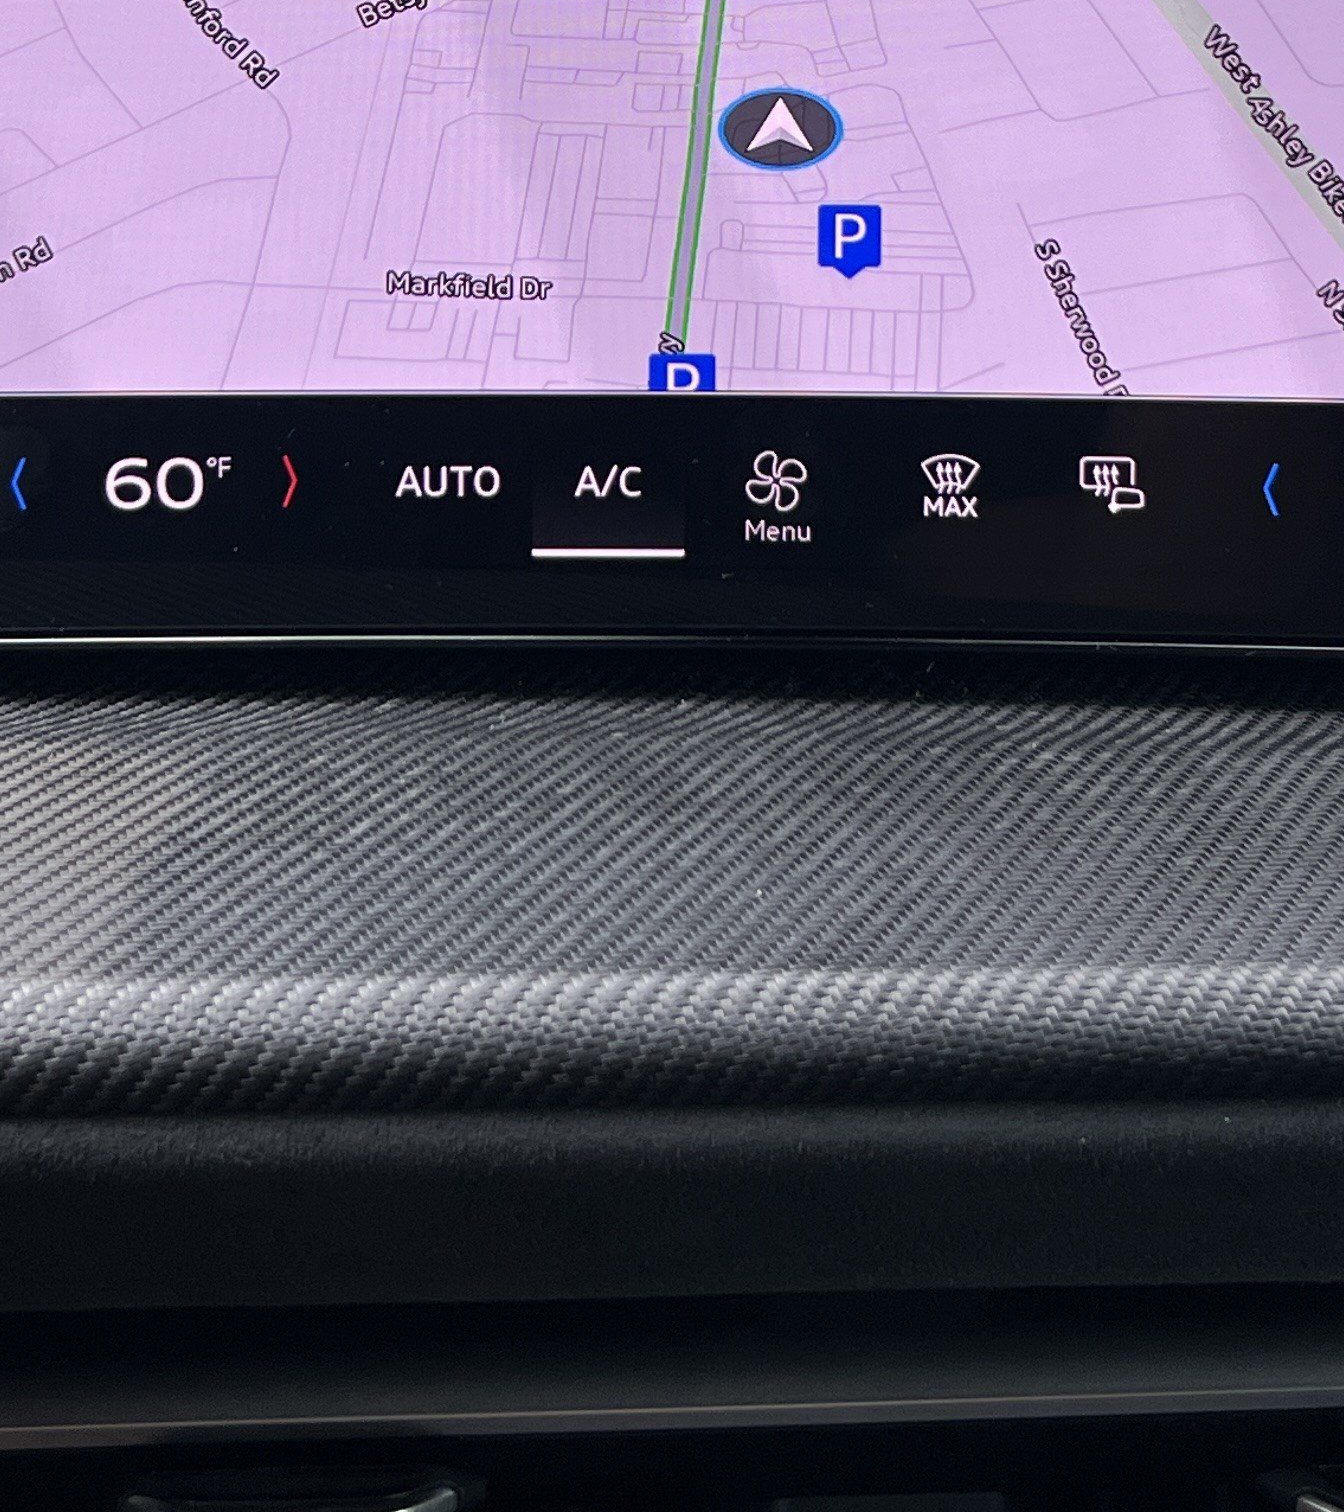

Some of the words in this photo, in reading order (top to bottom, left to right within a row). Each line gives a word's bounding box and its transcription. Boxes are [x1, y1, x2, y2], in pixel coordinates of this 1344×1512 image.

[239, 48, 280, 90] Rd
[1204, 24, 1262, 94] West
[1246, 96, 1315, 169] Ashley
[834, 213, 866, 260] P
[1034, 239, 1061, 261] S
[12, 236, 53, 272] Rd
[386, 270, 513, 300] Markfield
[519, 276, 552, 302] Dr
[1044, 260, 1121, 385] Sherwood
[395, 464, 501, 498] AUTO
[573, 464, 642, 498] A/C
[922, 495, 978, 518] MAX
[744, 519, 812, 542] Menu
